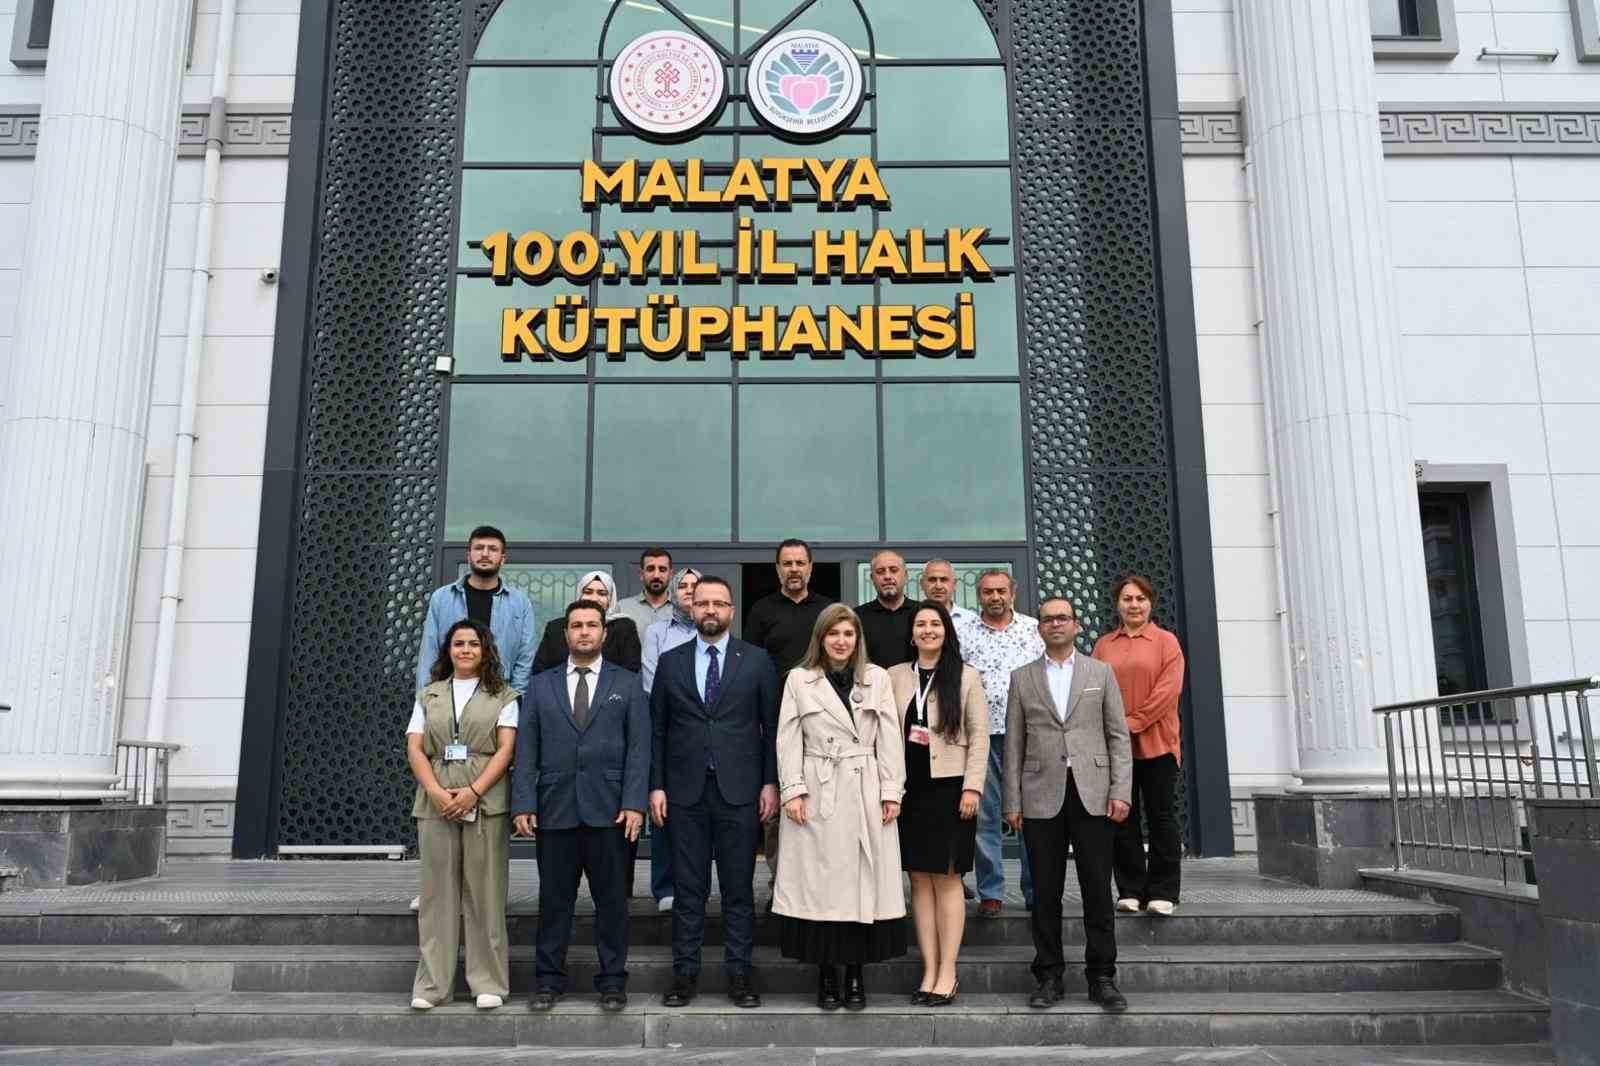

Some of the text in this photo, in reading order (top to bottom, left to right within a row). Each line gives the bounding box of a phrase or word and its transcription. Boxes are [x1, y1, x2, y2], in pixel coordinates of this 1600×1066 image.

[582, 158, 890, 203] MALATYA
[482, 216, 992, 276] 100.YIL İL HALK
[502, 292, 975, 355] KÜTÜPHANESİ
